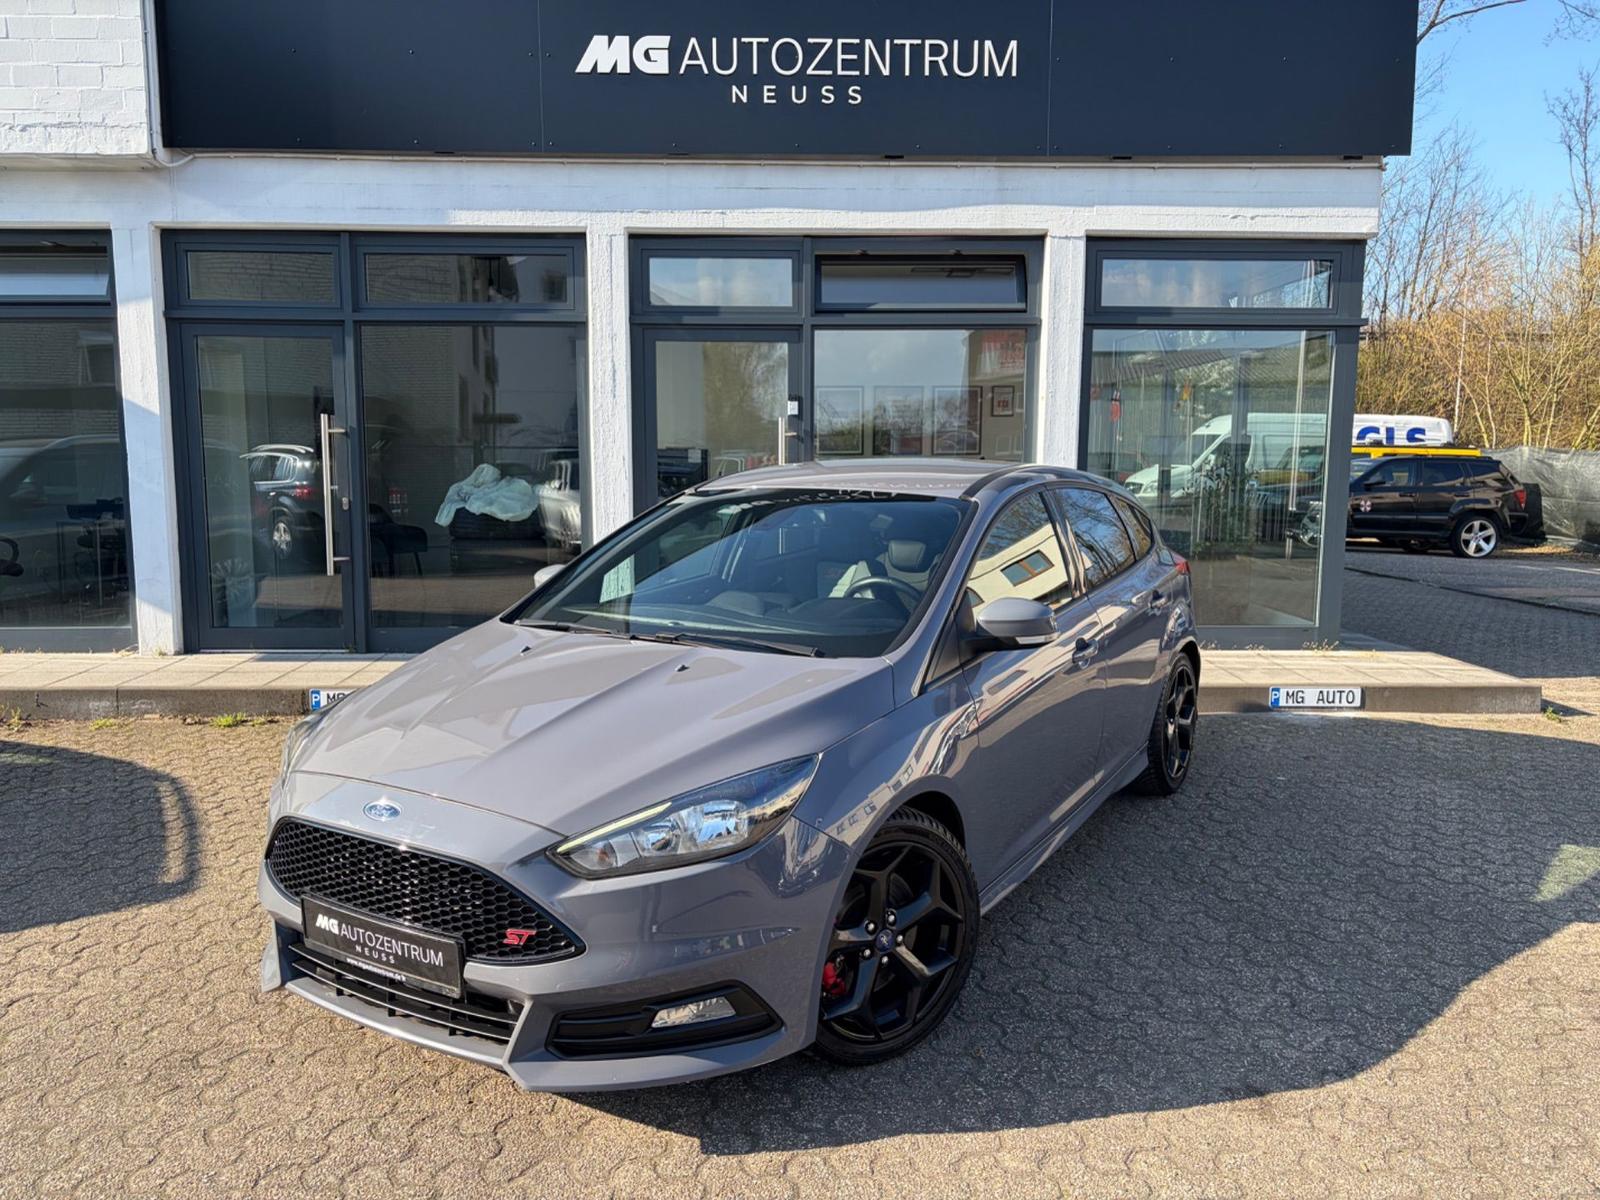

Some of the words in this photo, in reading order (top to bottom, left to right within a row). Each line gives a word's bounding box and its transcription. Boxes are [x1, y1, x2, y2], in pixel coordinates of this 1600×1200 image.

[575, 35, 671, 74] MG
[679, 37, 1018, 77] AUTOZENTRUM
[732, 84, 862, 104] NEUSS
[1285, 690, 1304, 704] MG
[1316, 690, 1355, 704] AUTO
[315, 913, 339, 935] MG
[340, 923, 444, 967] AUTOZENTRUM
[503, 928, 537, 945] ST
[355, 944, 396, 964] NEUSS
